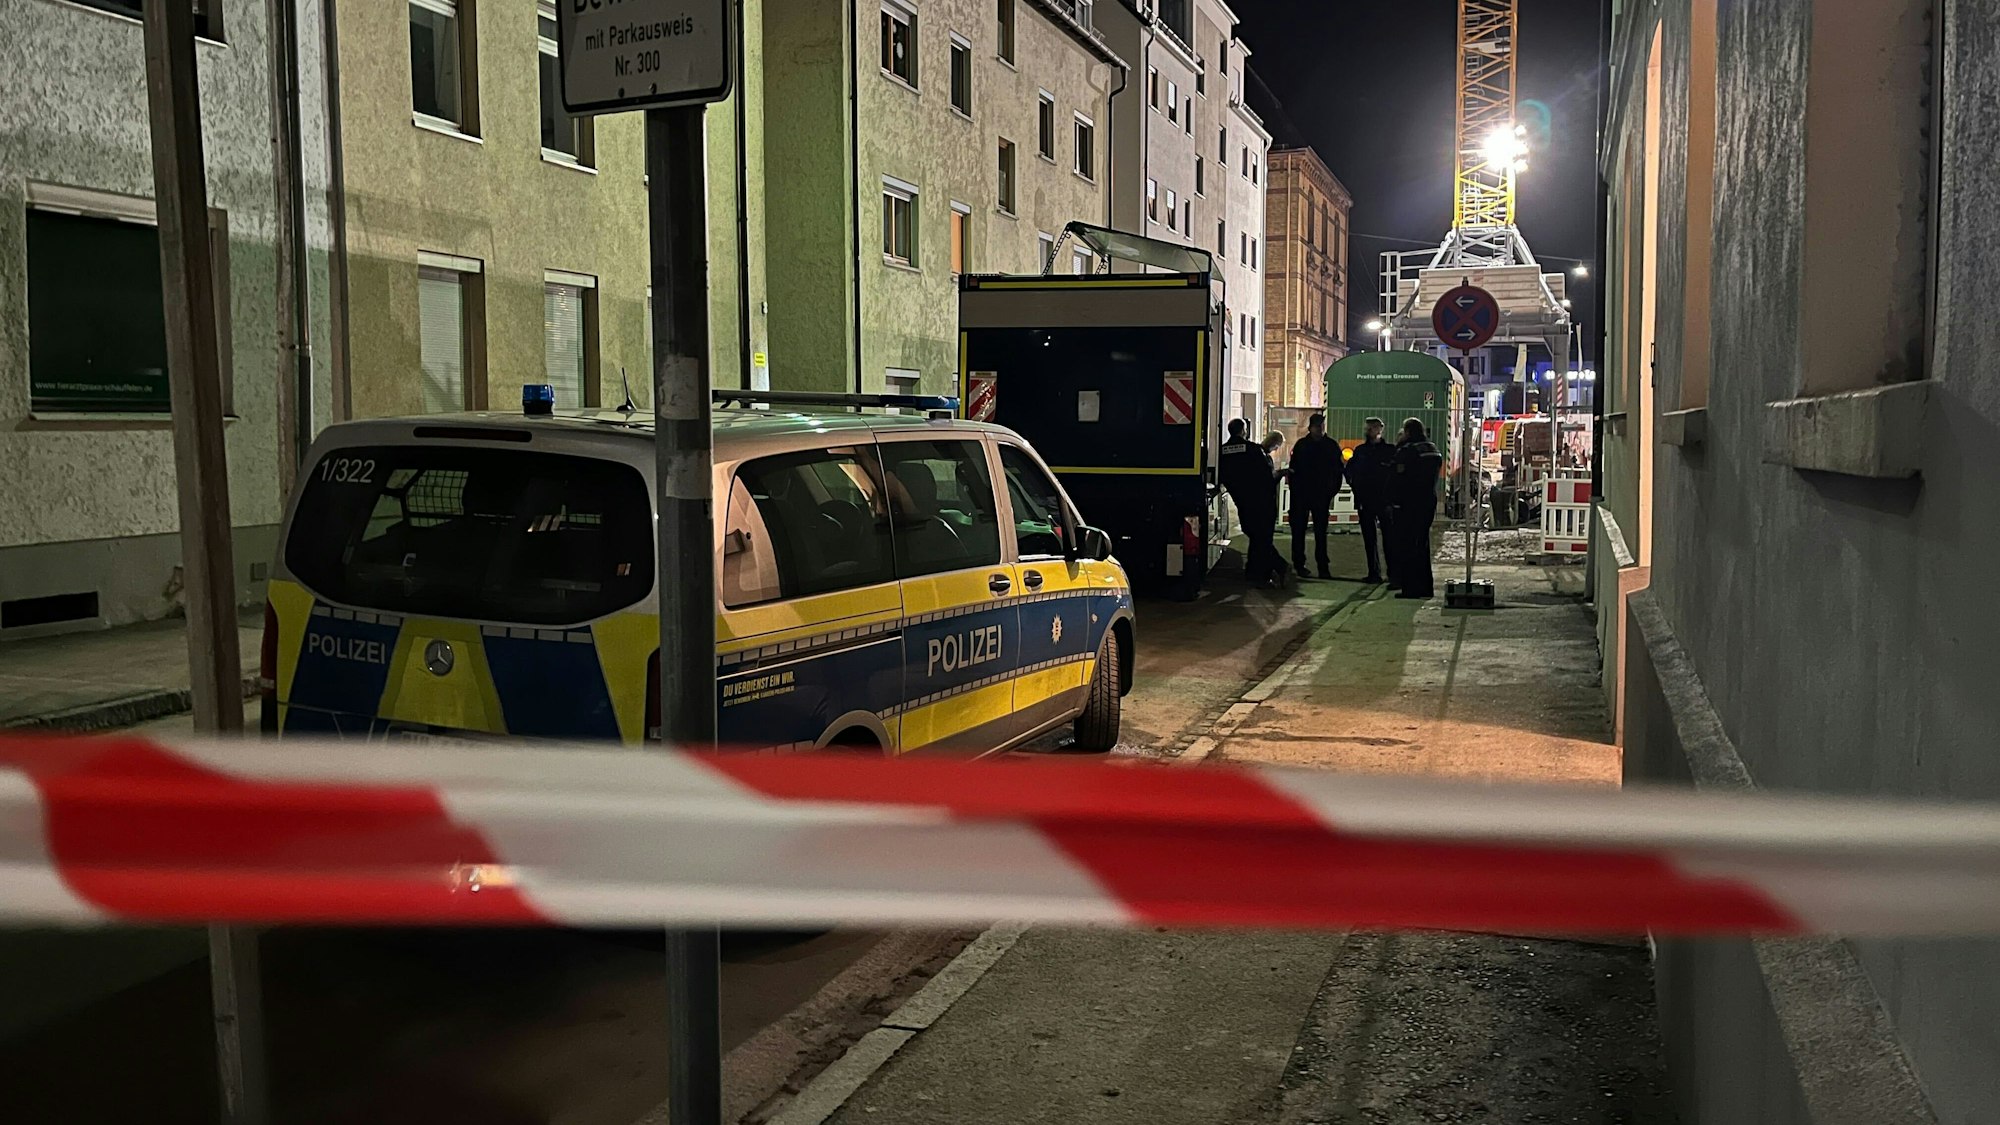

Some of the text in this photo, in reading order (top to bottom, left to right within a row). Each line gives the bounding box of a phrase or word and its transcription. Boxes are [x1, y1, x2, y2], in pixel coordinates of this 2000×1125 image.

[585, 12, 693, 50] mit Parkausweis
[615, 50, 661, 77] Nr. 300
[321, 458, 375, 483] 1/322
[308, 632, 386, 665] POLIZEI
[928, 624, 1002, 677] POLIZEI
[723, 684, 734, 697] DU
[734, 676, 769, 695] VERDIENST
[769, 673, 781, 687] EIN
